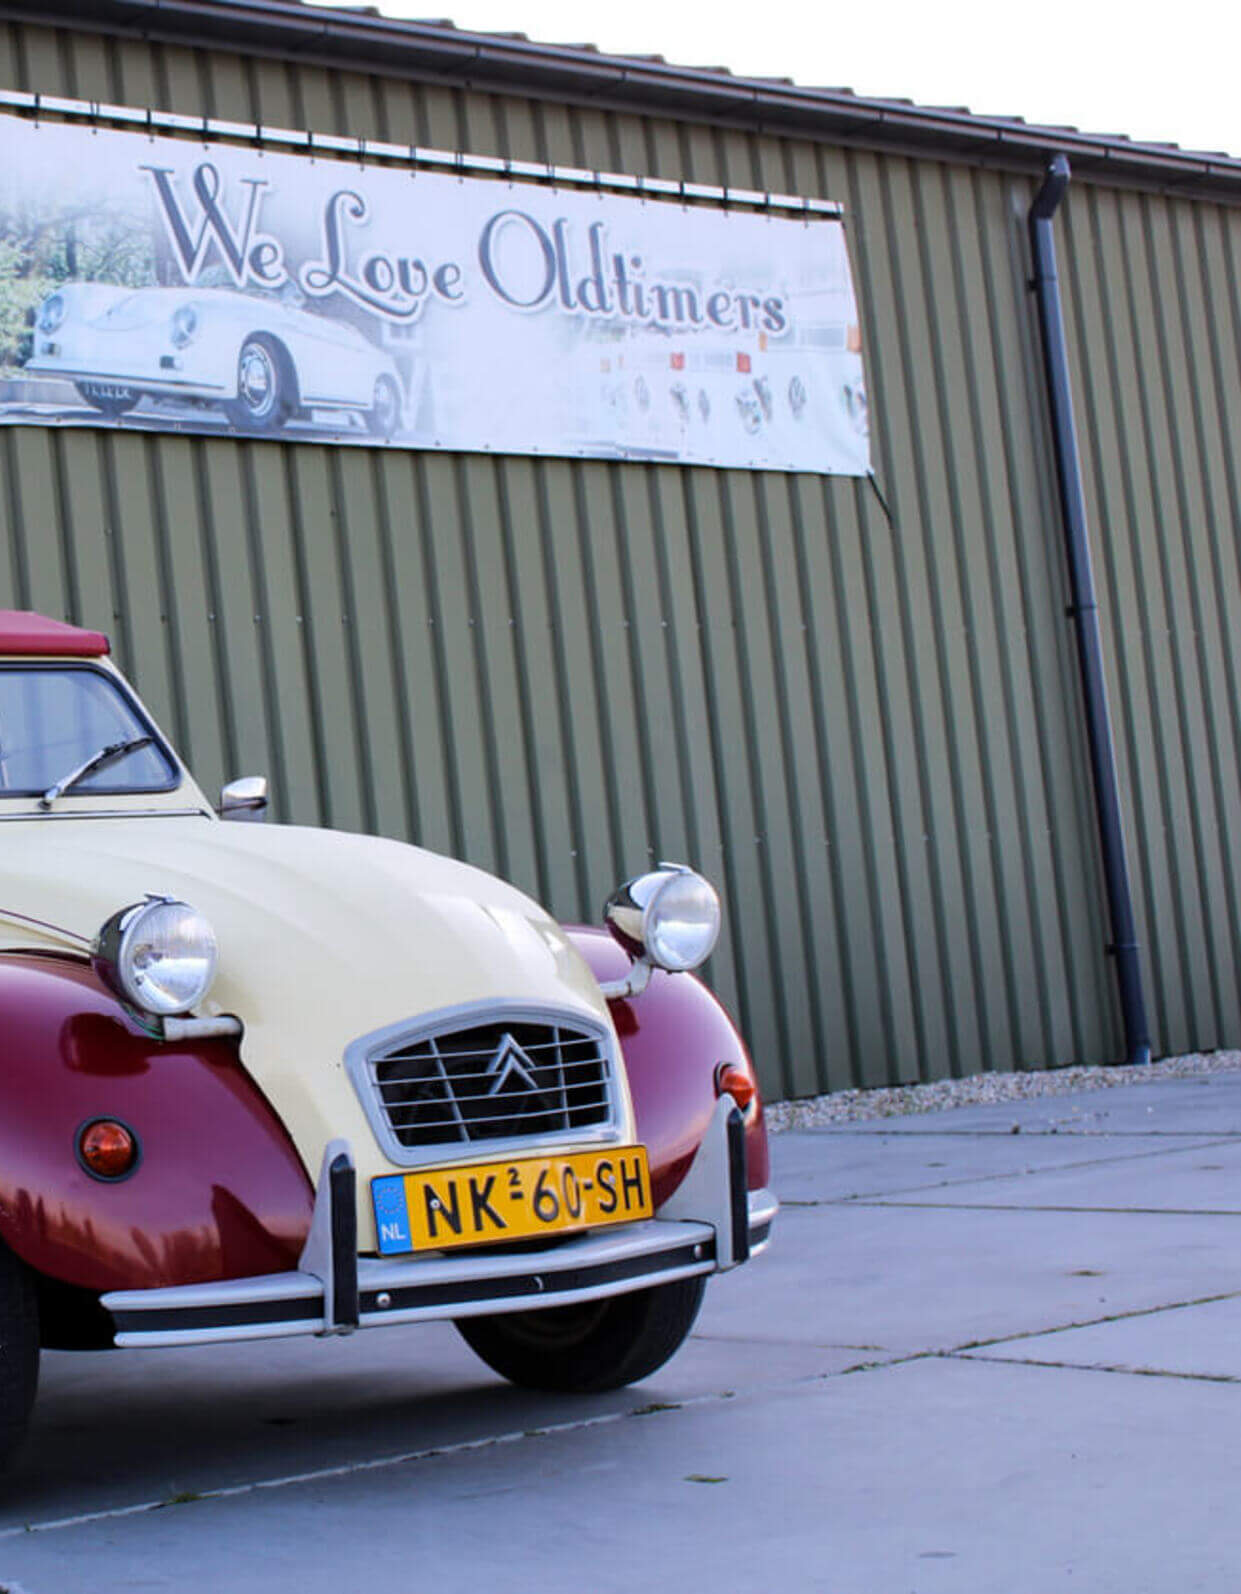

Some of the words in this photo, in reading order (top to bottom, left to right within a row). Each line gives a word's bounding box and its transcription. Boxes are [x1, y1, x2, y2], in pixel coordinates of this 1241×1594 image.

[138, 161, 284, 282] We
[301, 189, 463, 319] Love
[477, 209, 788, 333] Oldtimers
[380, 1223, 406, 1241] NL
